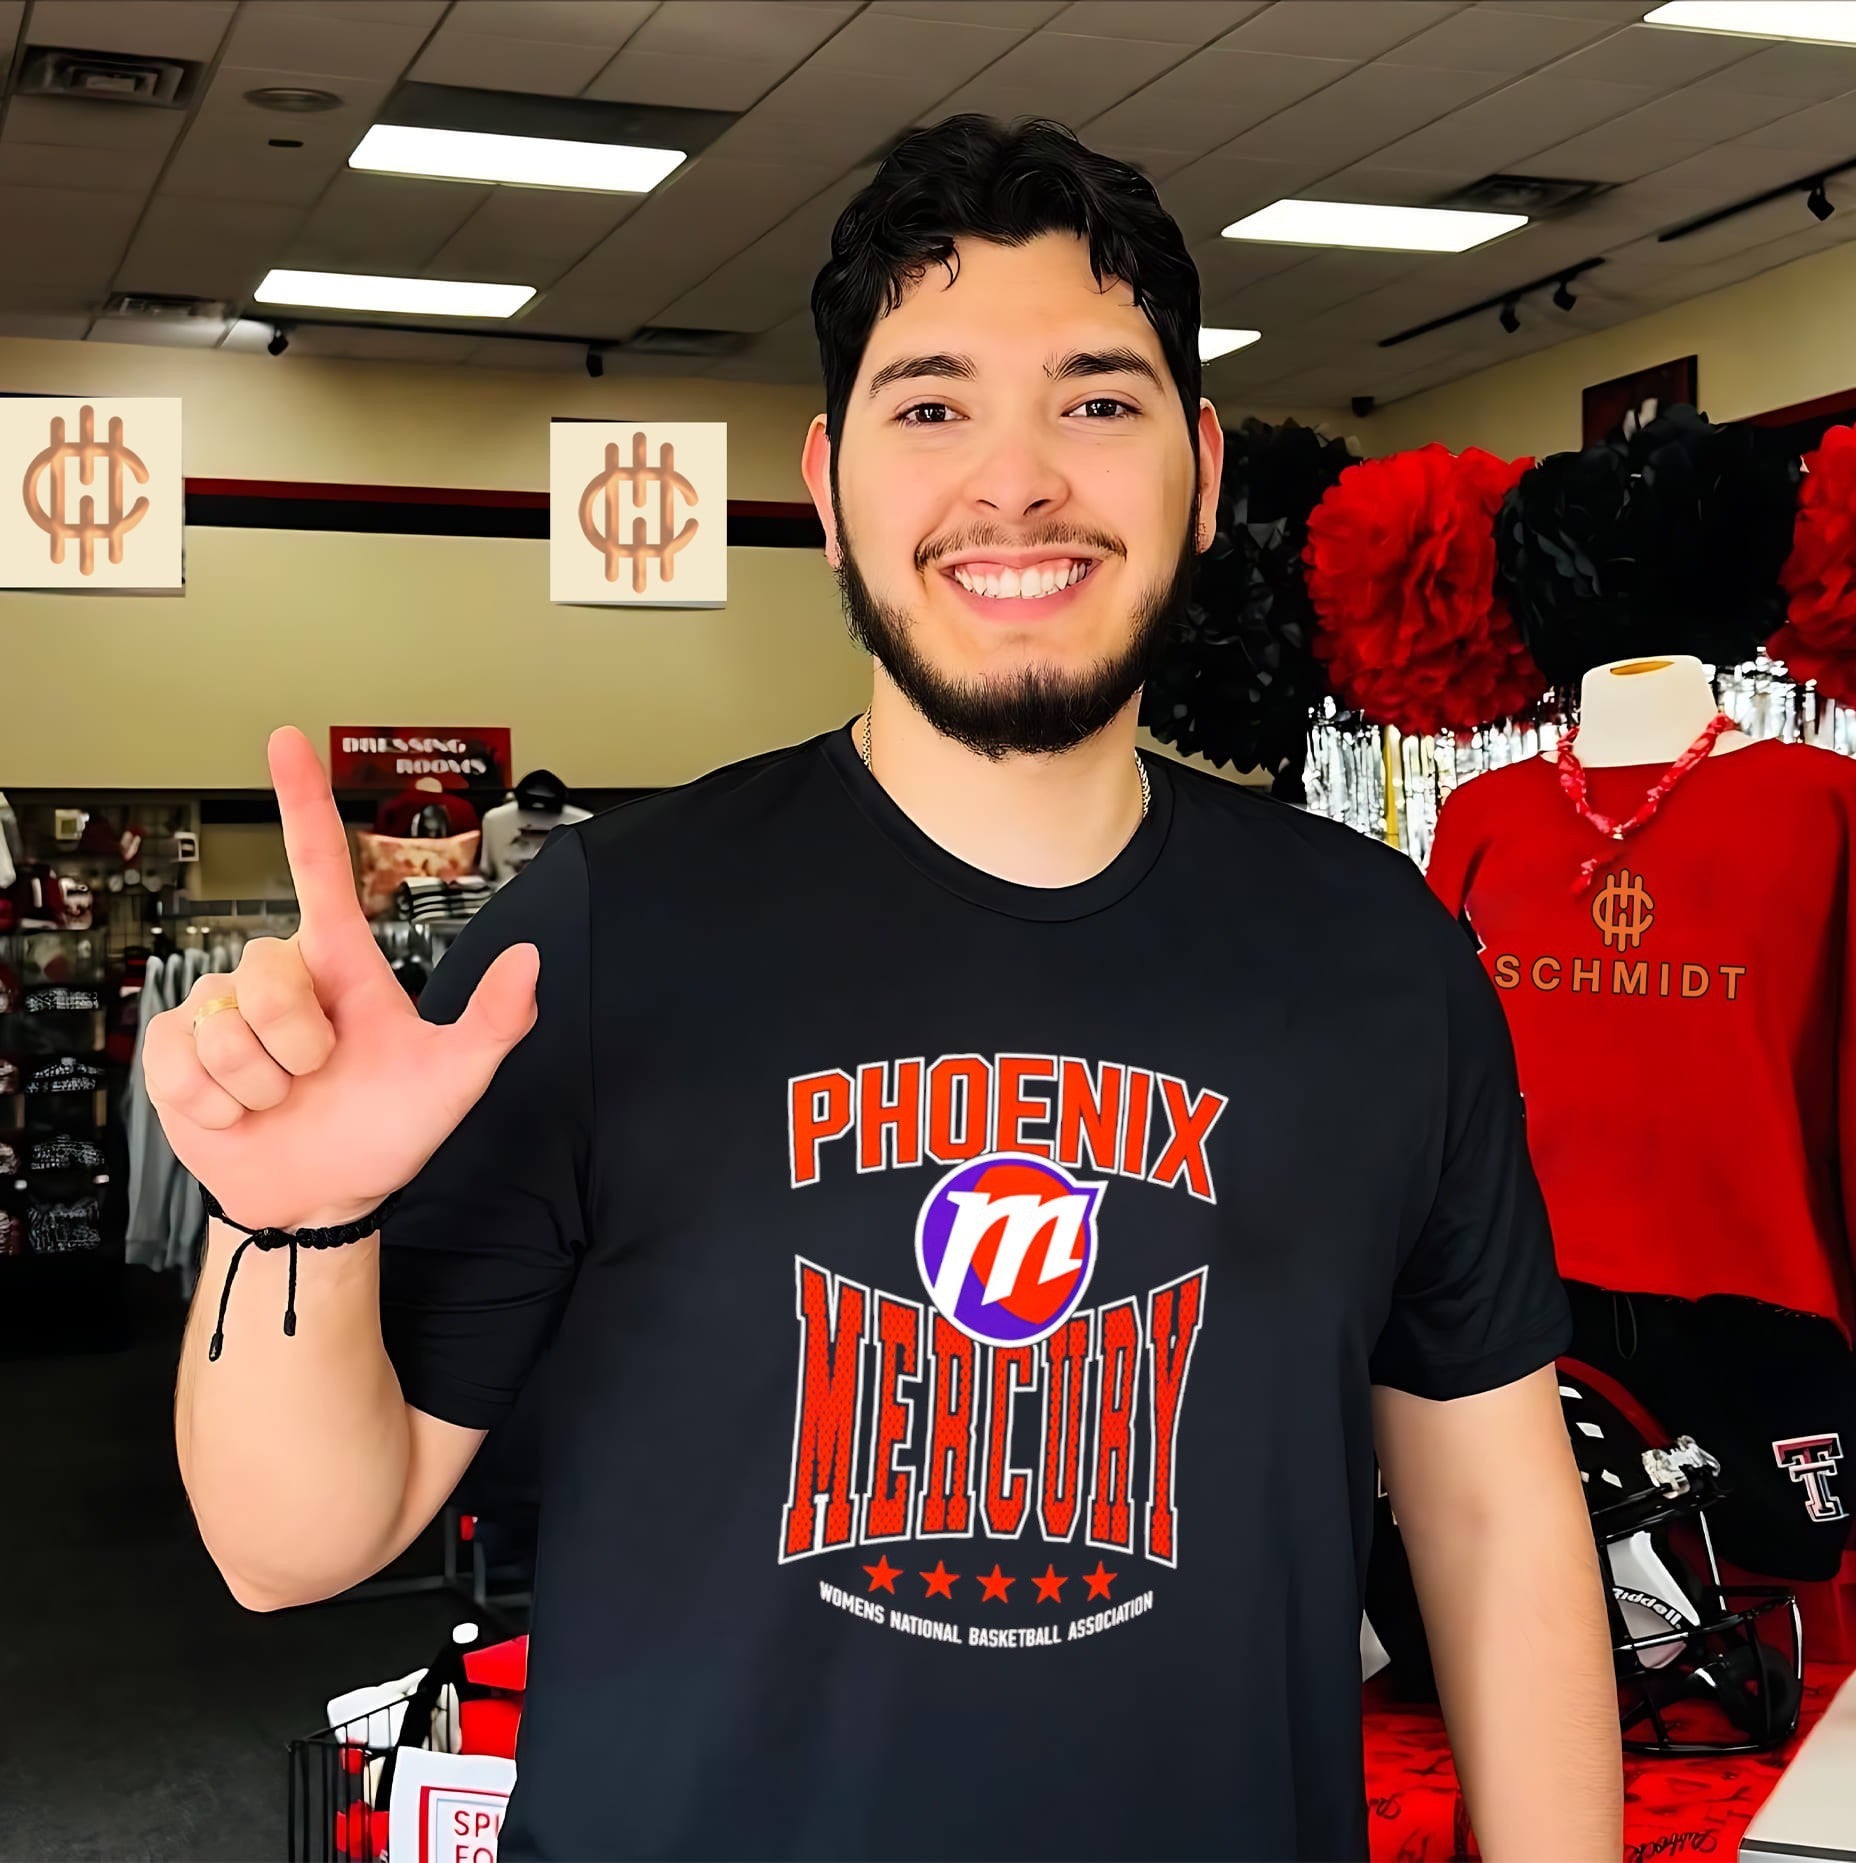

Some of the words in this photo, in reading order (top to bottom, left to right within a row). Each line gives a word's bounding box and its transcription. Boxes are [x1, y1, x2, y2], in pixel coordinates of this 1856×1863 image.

[342, 737, 467, 754] DRESSING
[396, 758, 487, 775] ROOMS
[1493, 953, 1747, 1001] SCHMIDT
[787, 1052, 1229, 1205] PHOENIX
[777, 1253, 1209, 1569] MERCURY
[819, 1580, 885, 1625] WOMENS
[889, 1609, 963, 1645] NATIONAL
[968, 1624, 1062, 1649] BASKETBALL
[1067, 1589, 1154, 1642] ASSOCIATION
